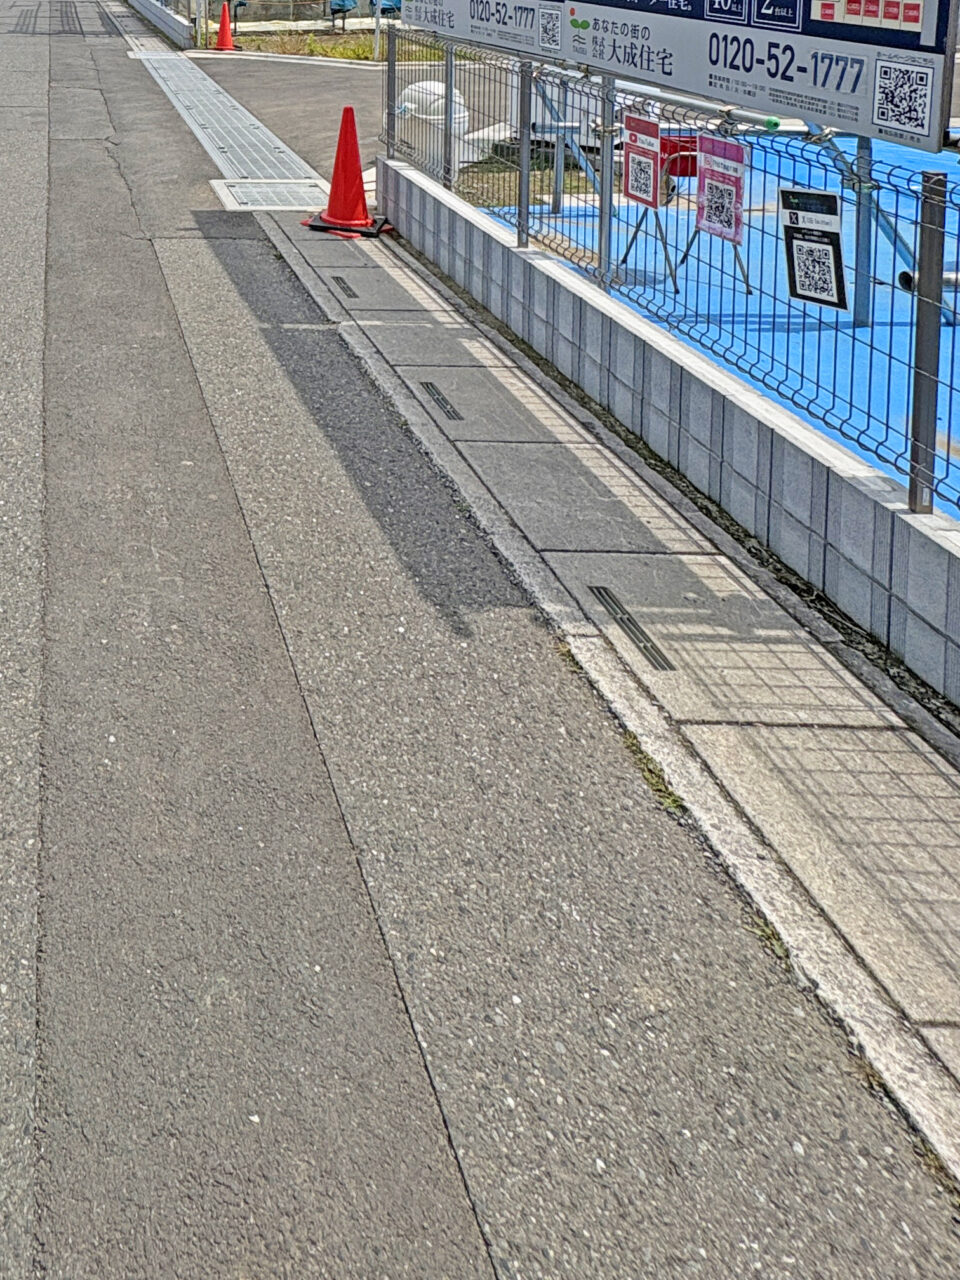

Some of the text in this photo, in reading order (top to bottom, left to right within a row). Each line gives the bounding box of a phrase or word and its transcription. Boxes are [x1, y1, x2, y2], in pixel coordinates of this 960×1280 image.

[423, 6, 455, 29] 大成住宅
[592, 18, 651, 41] あなたの街の
[607, 38, 673, 76] 大成住宅
[709, 32, 865, 94] 0120-52-1777
